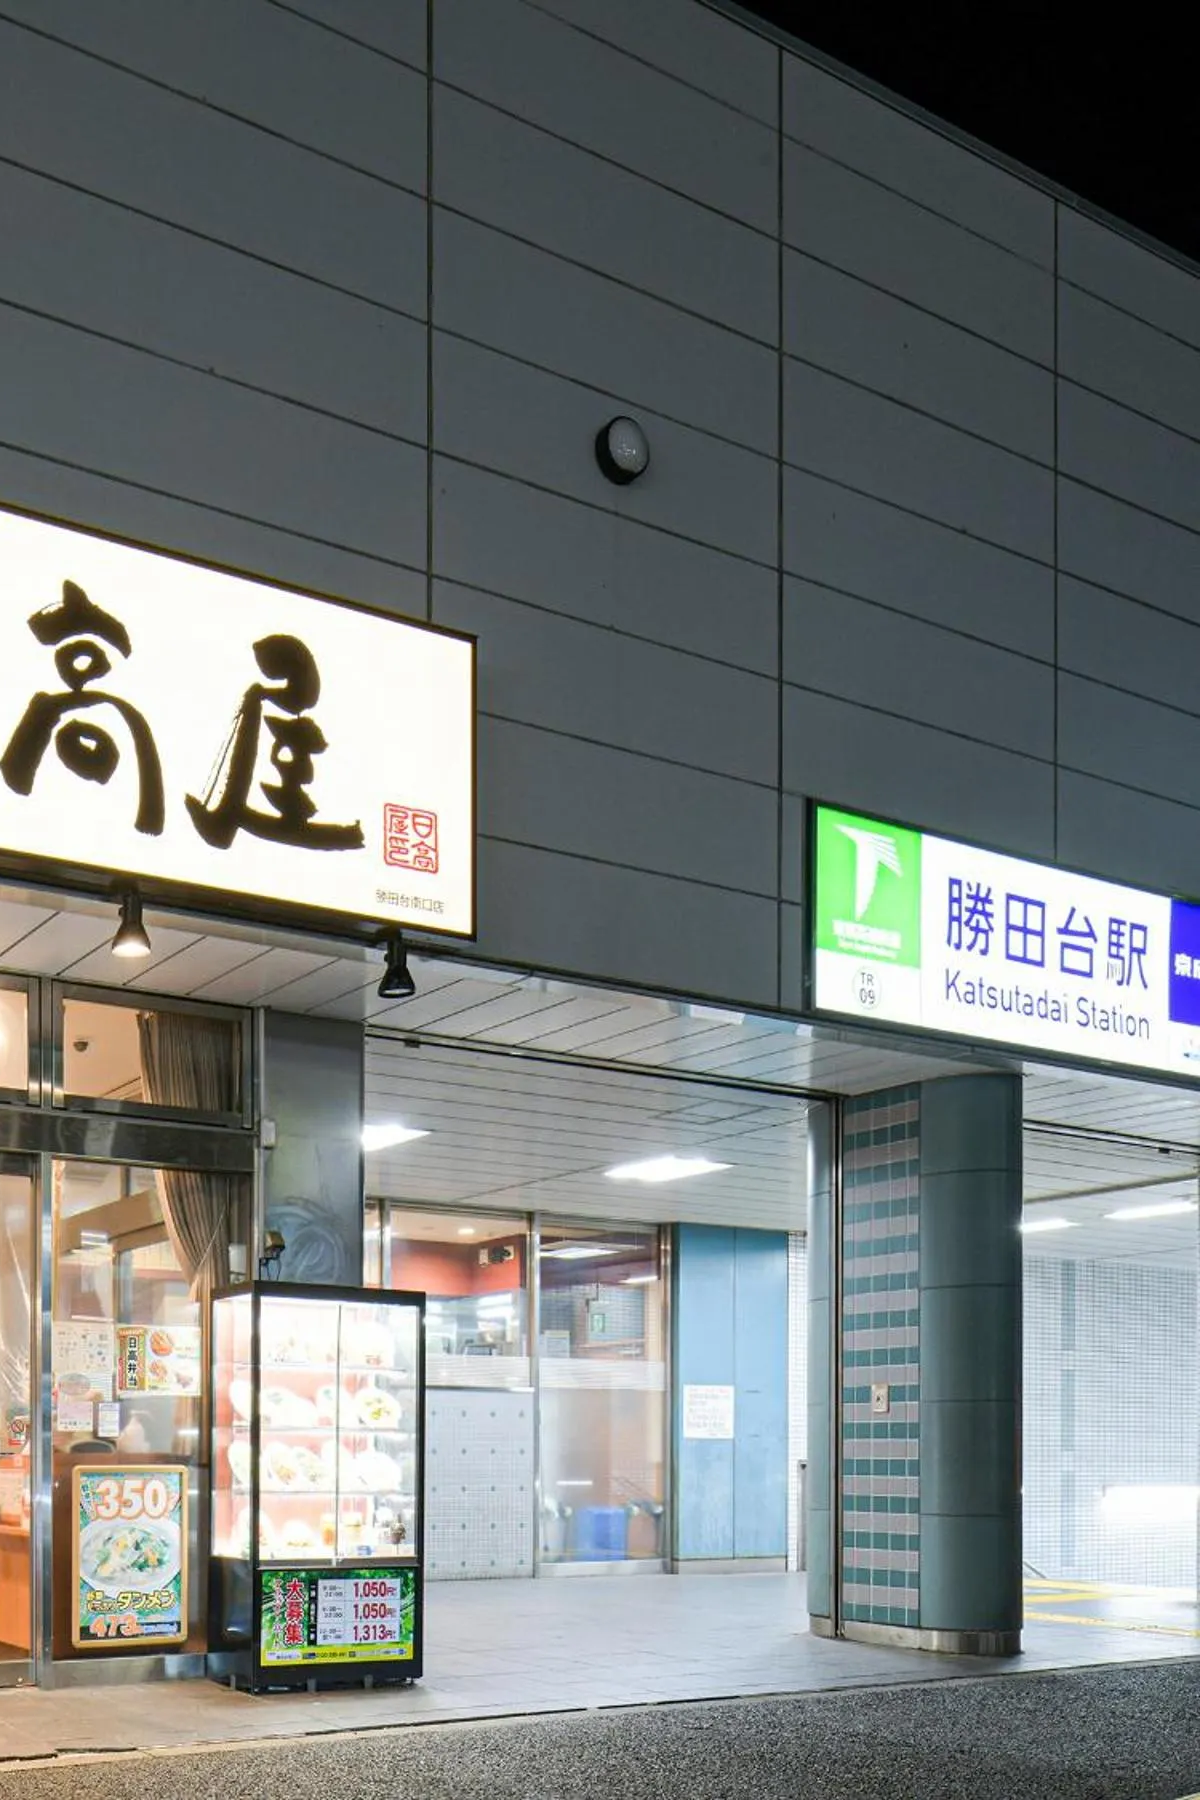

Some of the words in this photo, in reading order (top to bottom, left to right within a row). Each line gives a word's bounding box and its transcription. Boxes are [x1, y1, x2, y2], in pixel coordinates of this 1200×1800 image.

[945, 876, 1149, 990] 勝田台駅
[859, 987, 876, 1005] 09
[860, 972, 875, 986] TR
[944, 968, 1069, 1025] Katsutadai
[1076, 998, 1150, 1040] Station
[284, 1578, 305, 1644] 大募集
